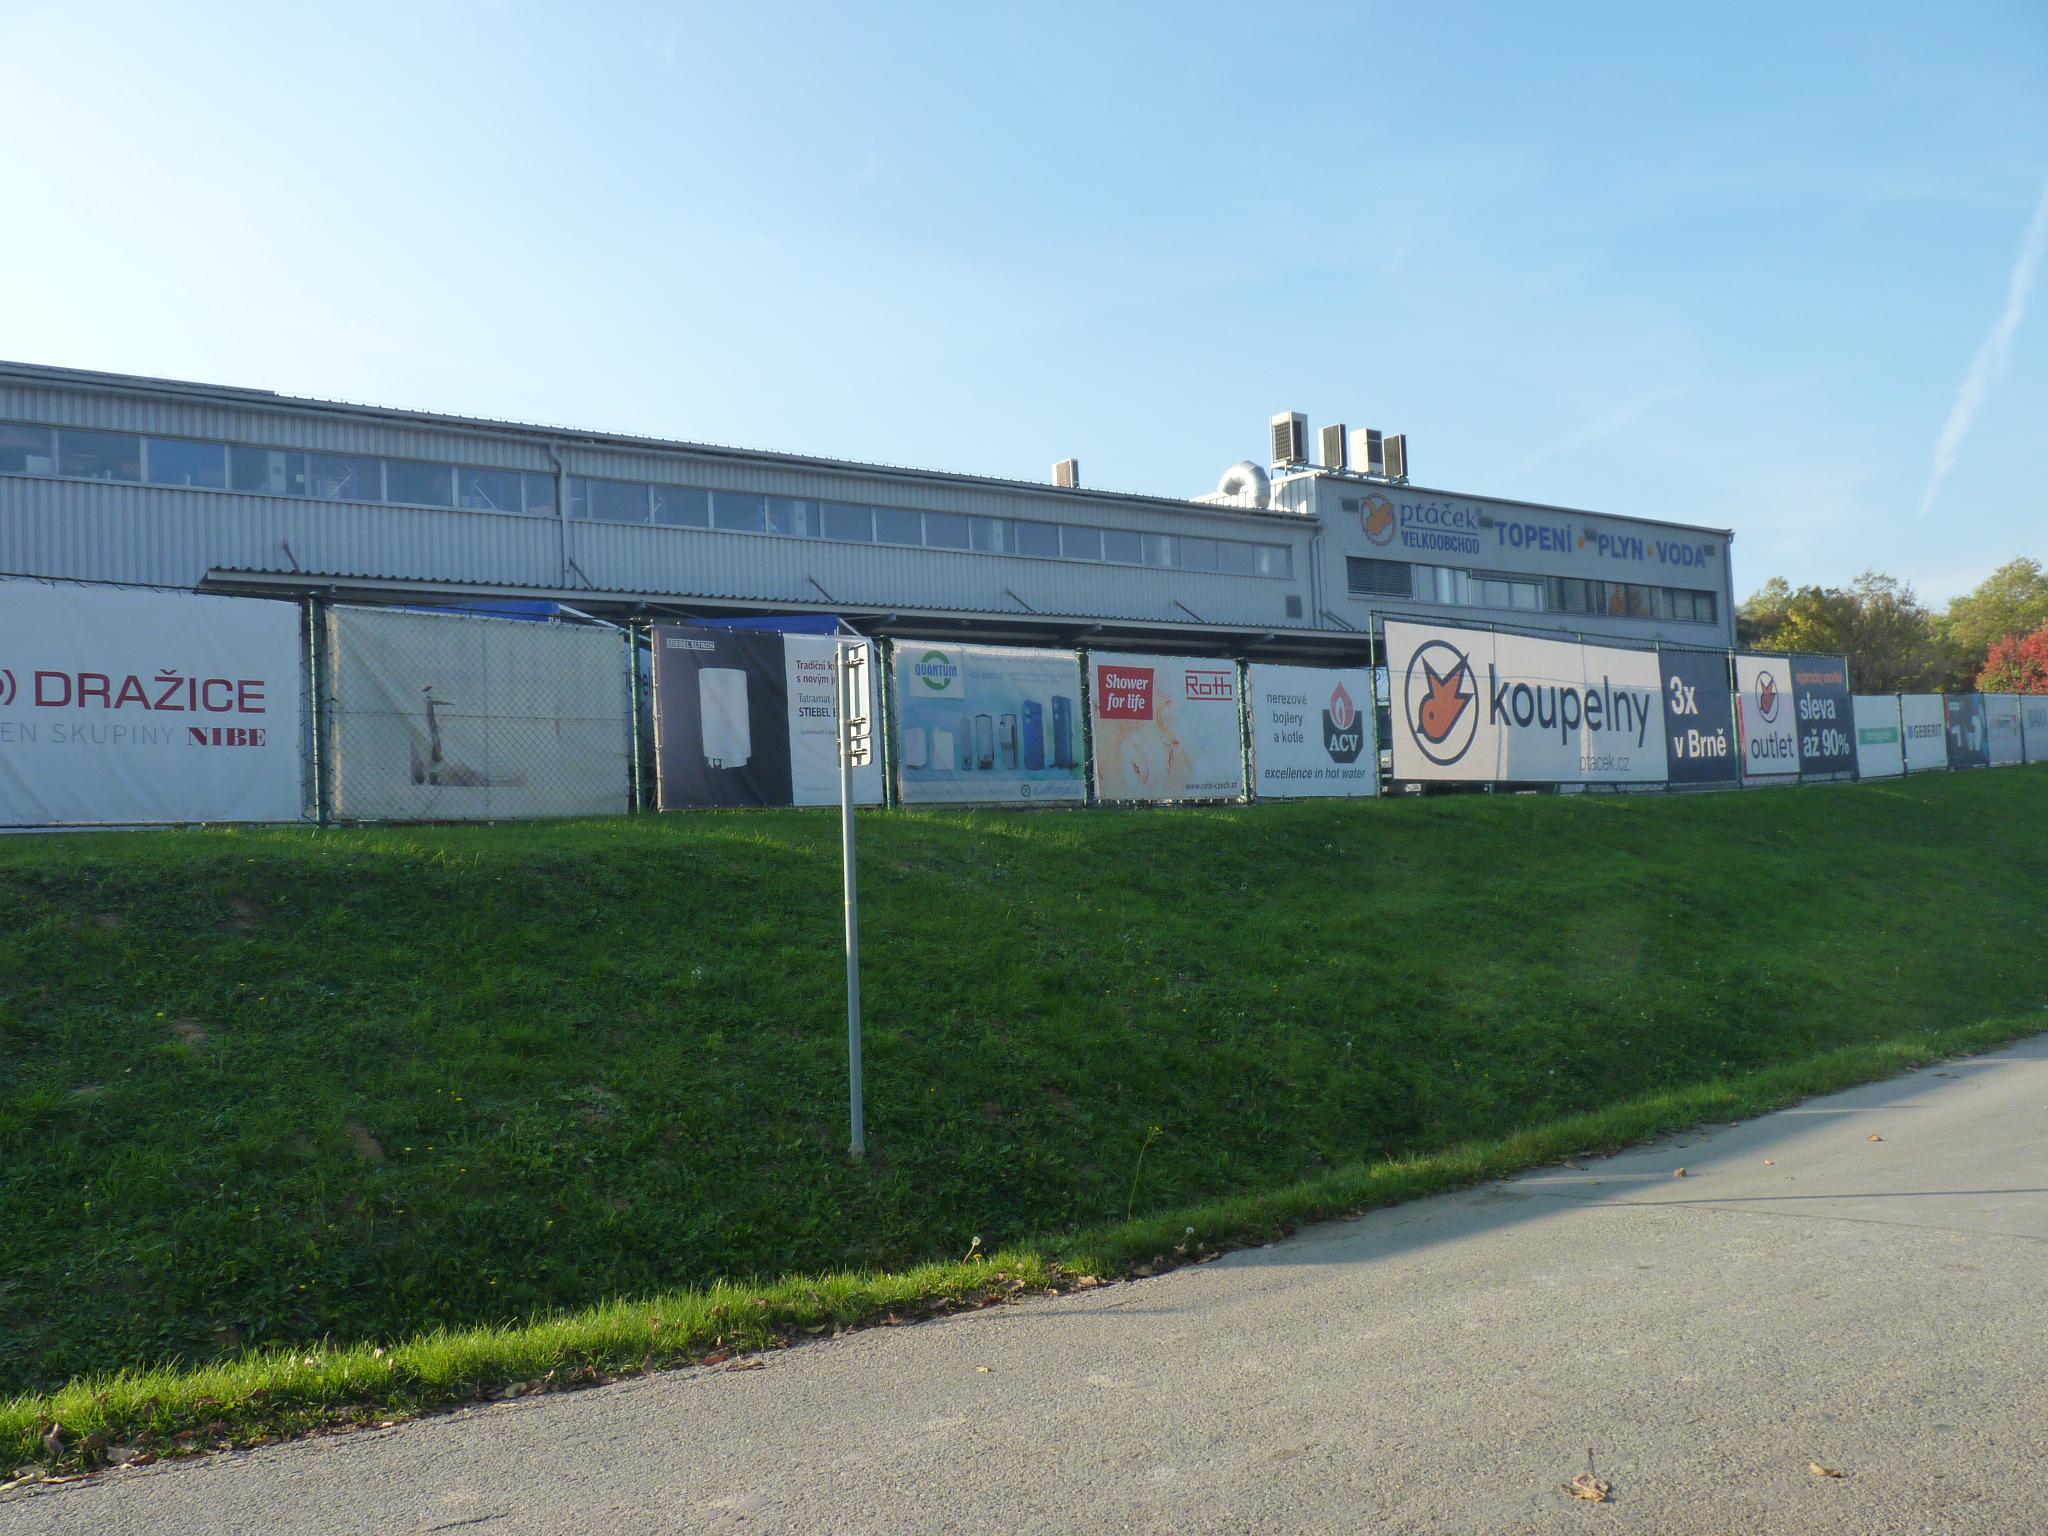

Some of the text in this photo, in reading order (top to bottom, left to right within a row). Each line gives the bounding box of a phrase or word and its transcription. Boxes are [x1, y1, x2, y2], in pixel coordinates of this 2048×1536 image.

[1401, 500, 1478, 529] ptáček
[1401, 530, 1480, 555] VELKOOBCHOD
[1495, 519, 1706, 569] TOPENÍ PLYN VODA
[796, 659, 826, 671] Tradiční
[915, 662, 958, 678] QUANTUM
[796, 675, 801, 683] s
[803, 673, 829, 686] novým
[1105, 672, 1149, 691] Shower
[1185, 674, 1233, 696] Roth
[34, 668, 266, 713] DRAŽICE
[798, 692, 831, 704] Tatramat
[1265, 692, 1307, 705] nerezové
[1669, 676, 1699, 716] 3x
[1107, 693, 1146, 712] for life
[1488, 662, 1650, 748] koupelny
[1799, 692, 1836, 720] sleva
[798, 707, 831, 718] STIEBEL
[1272, 711, 1303, 727] bojlery
[51, 723, 175, 744] SKUPINY
[187, 726, 266, 746] NIBE
[1273, 731, 1305, 743] a kotle
[1913, 723, 1942, 739] GEBERIT
[1328, 734, 1359, 752] ACV
[1673, 726, 1728, 758] v Brně
[1750, 730, 1794, 760] outlet
[1802, 728, 1850, 757] až 90%
[1264, 767, 1366, 779] excellence in hot water
